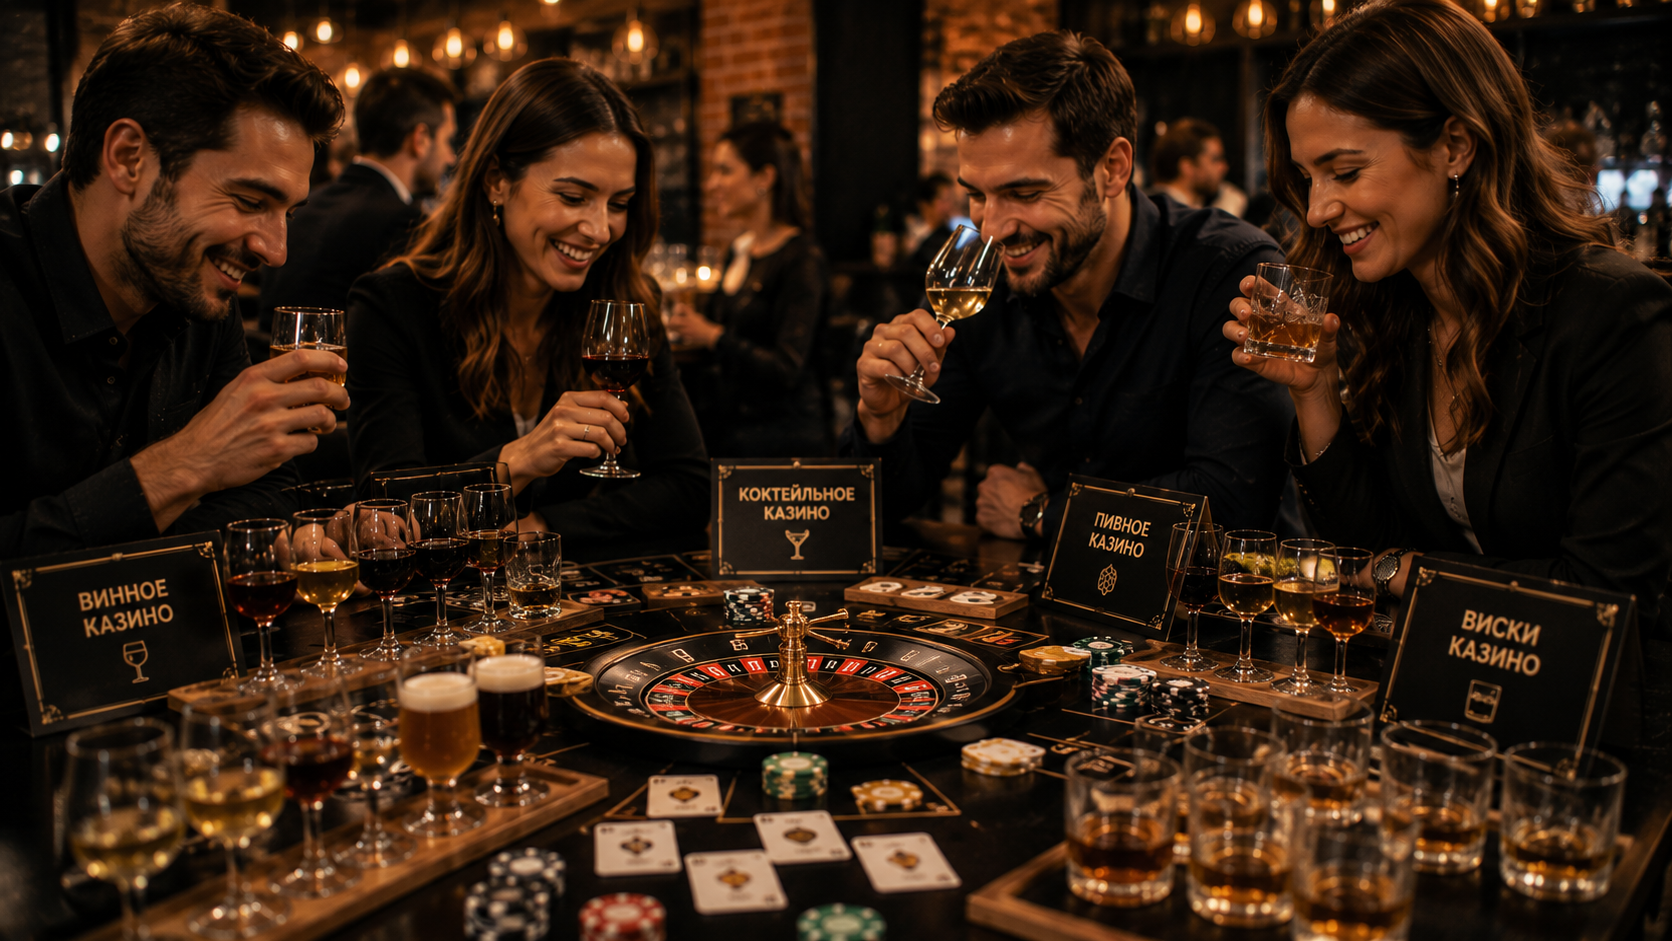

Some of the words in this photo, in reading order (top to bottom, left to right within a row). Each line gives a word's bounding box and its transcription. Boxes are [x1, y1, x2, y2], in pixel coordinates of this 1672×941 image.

[739, 484, 855, 501] КОКТЕЙЛЬНОЕ
[764, 505, 830, 520] КАЗИНО
[1094, 511, 1151, 537] ПИВНОЕ
[1088, 532, 1145, 558] КАЗИНО
[78, 578, 169, 611] ВИННОЕ
[83, 604, 174, 638] КАЗИНО
[1461, 609, 1541, 647] ВИСКИ
[1448, 635, 1541, 677] КАЗИНО
